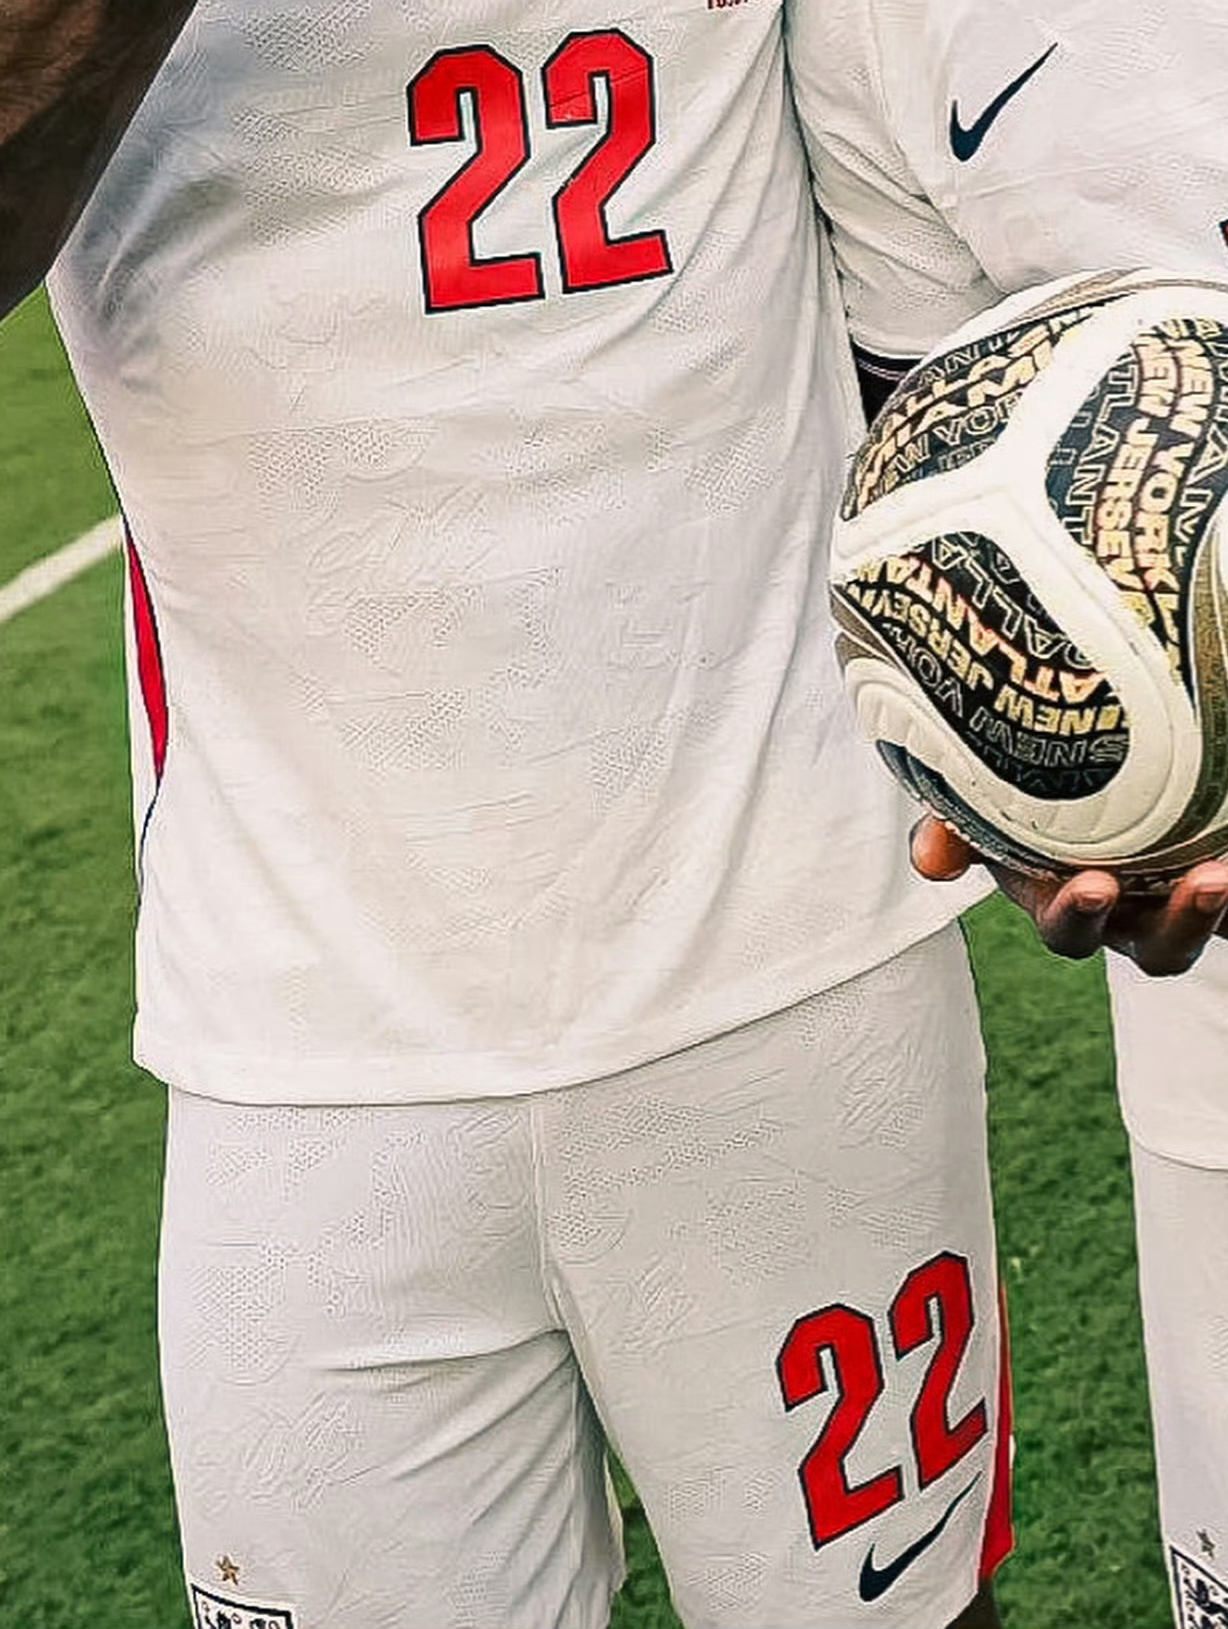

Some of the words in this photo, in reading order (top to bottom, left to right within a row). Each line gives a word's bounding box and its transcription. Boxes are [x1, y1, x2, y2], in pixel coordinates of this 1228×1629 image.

[407, 28, 674, 316] 22
[1063, 354, 1138, 547] TLANT
[1164, 336, 1214, 440] NEW
[1097, 417, 1159, 591] JERSEY
[1134, 442, 1196, 592] YORK
[871, 589, 995, 690] JERSEY
[887, 556, 1111, 705] ATLANTA
[931, 533, 1093, 669] ALLA
[994, 684, 1098, 736] NEW
[776, 1250, 989, 1551] 22
